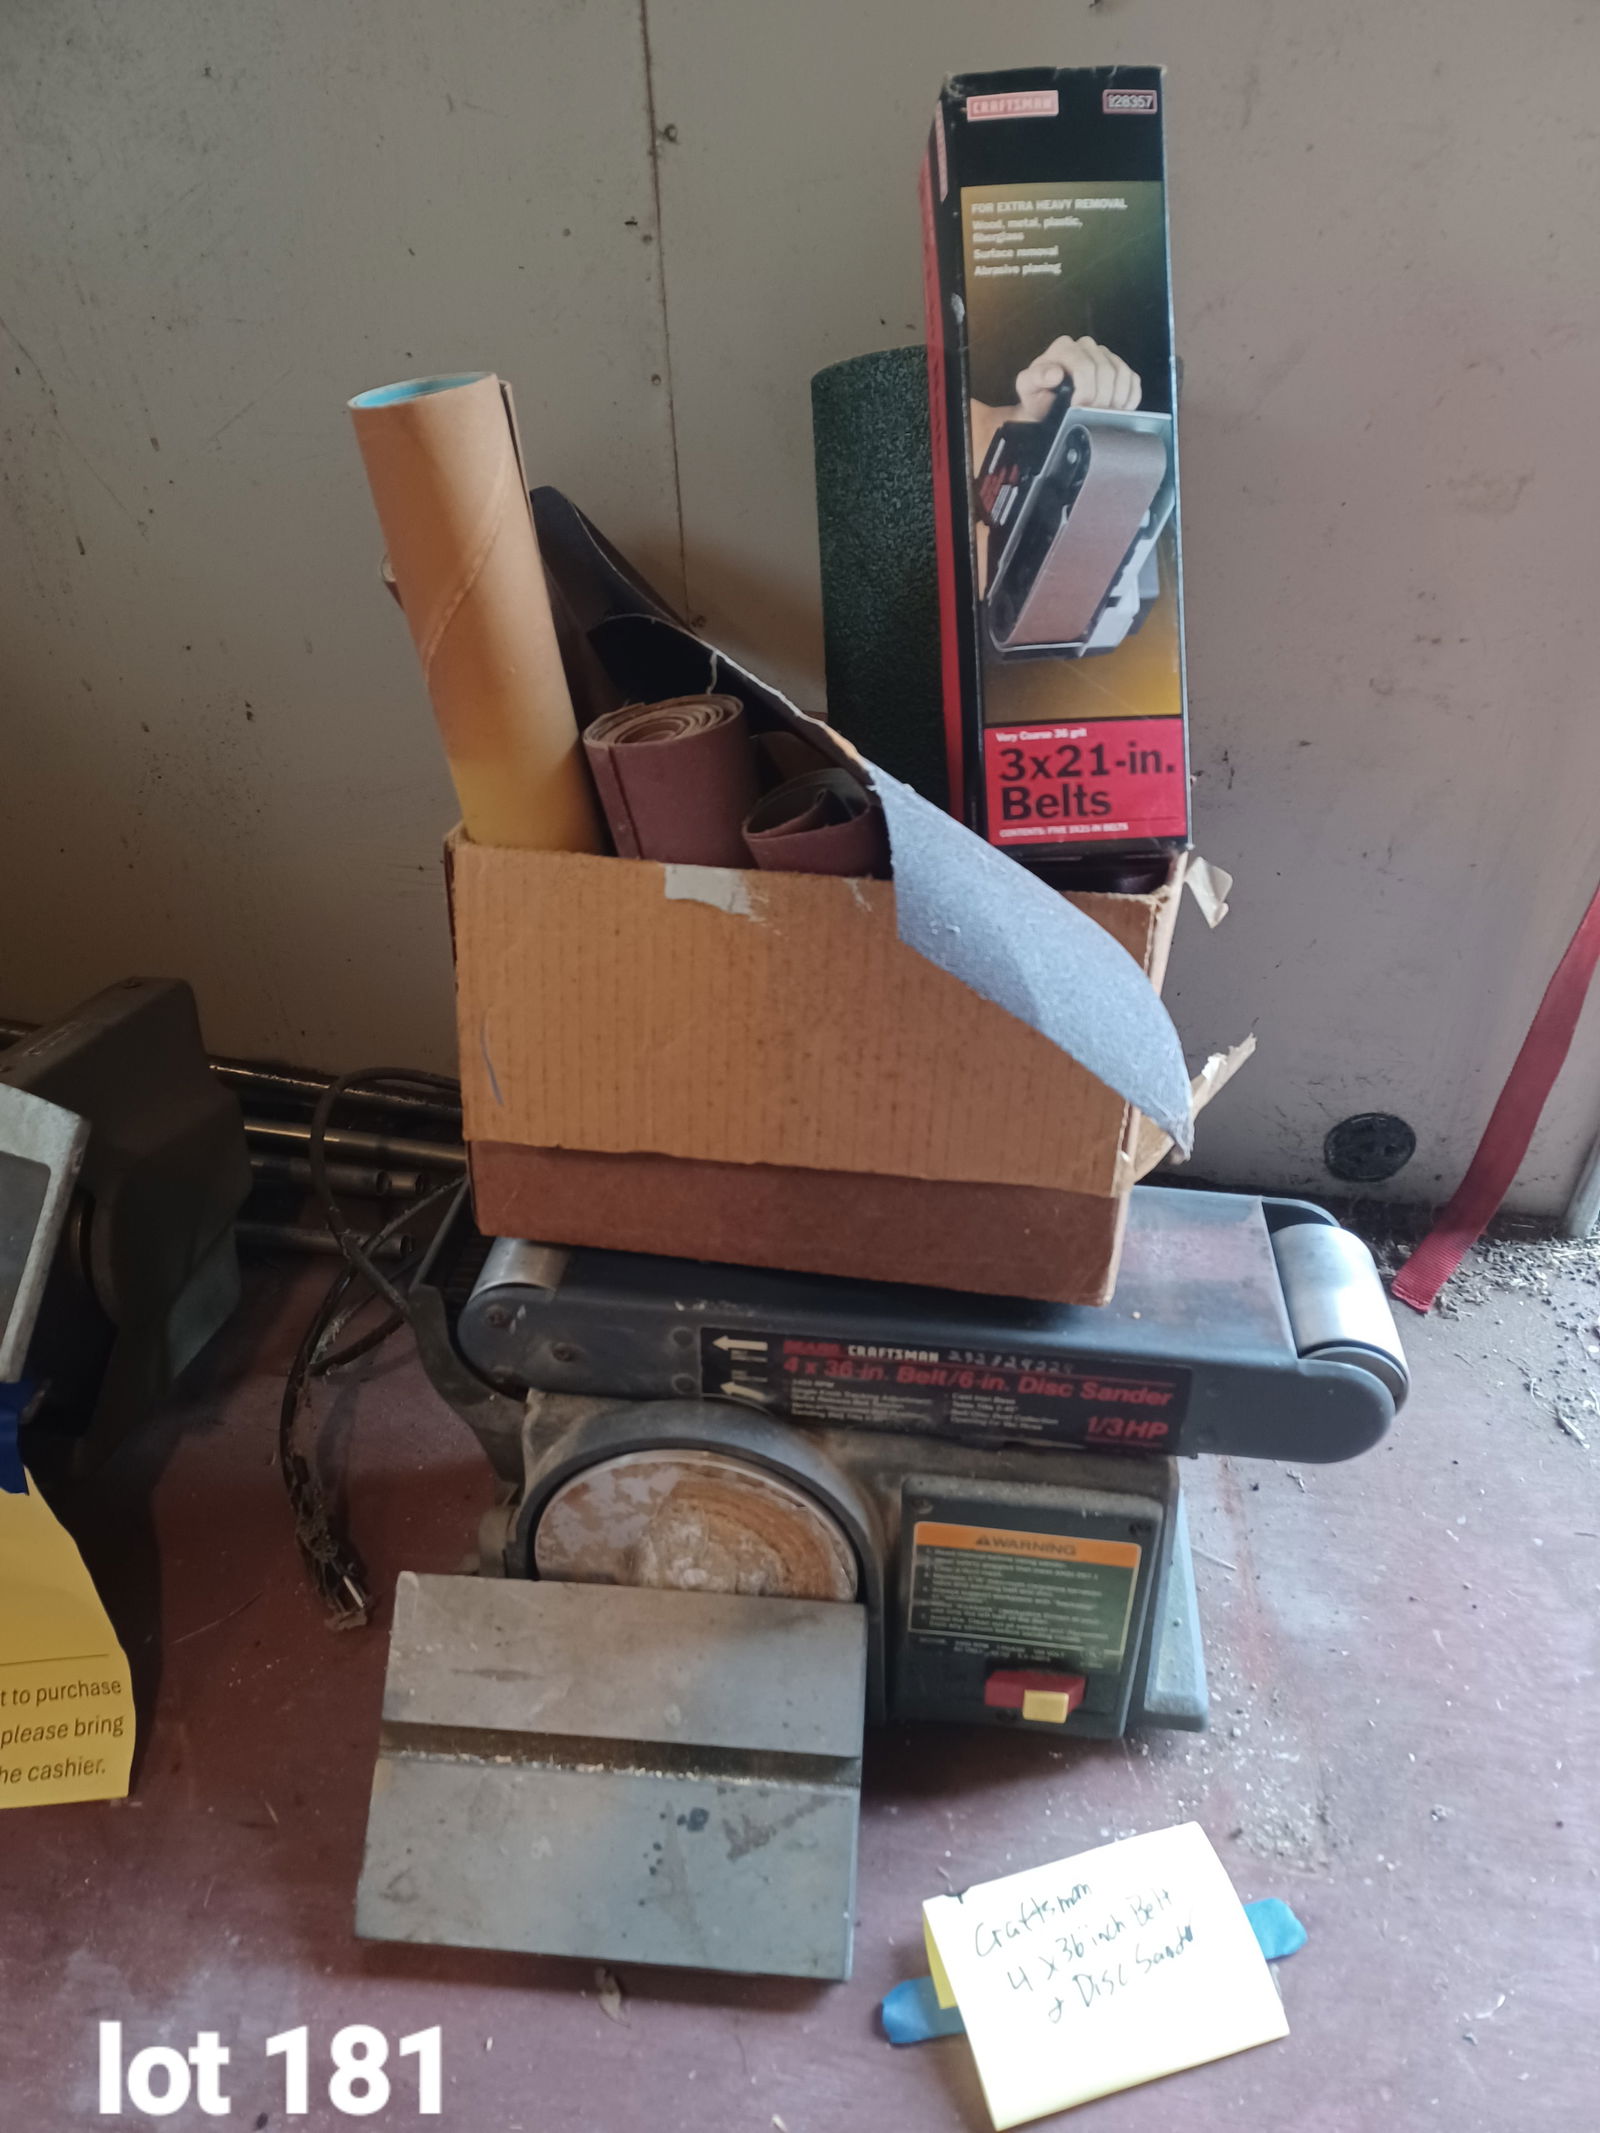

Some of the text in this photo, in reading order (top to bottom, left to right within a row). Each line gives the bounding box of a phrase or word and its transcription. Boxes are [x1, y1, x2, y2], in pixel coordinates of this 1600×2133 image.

[971, 198, 1128, 213] FOR EXTRA HEAVY REMOVAL
[974, 264, 1020, 276] Abrasive
[1000, 741, 1175, 781] 3x21-in.
[1002, 783, 1111, 821] Belts
[848, 1345, 939, 1363] CRAFTSMAN
[784, 1357, 799, 1373] 4
[1018, 1376, 1073, 1398] Disc
[1080, 1380, 1173, 1406] Sander
[993, 1536, 1077, 1557] WARNING
[13, 1689, 31, 1706] to
[36, 1680, 122, 1707] purchase
[0, 1715, 125, 1749] please bring
[28, 1756, 106, 1782] cashier.
[1007, 1966, 1034, 1991] 4
